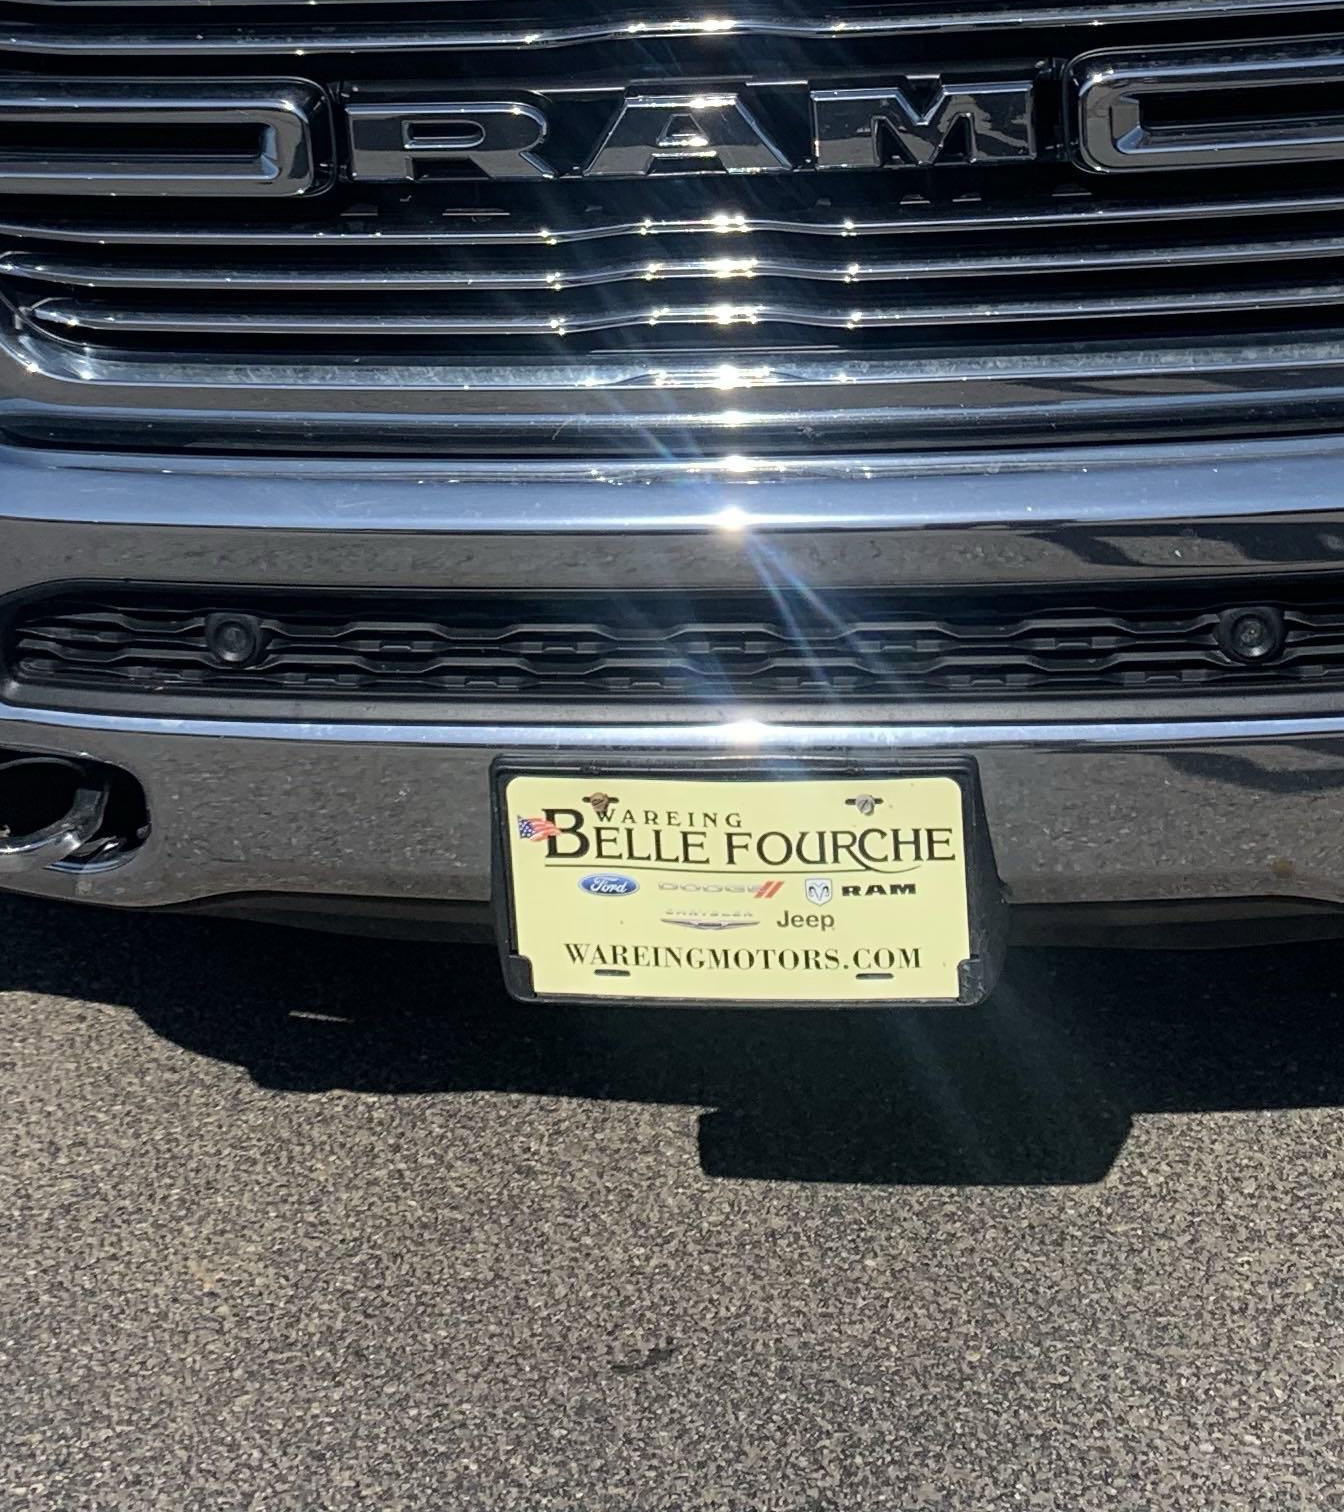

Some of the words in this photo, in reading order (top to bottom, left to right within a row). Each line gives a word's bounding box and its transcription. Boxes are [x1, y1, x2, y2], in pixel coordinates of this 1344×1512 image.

[344, 81, 1038, 181] RAM
[595, 808, 743, 828] WAREING
[541, 807, 710, 865] BELLE
[725, 827, 956, 871] FOURCHE
[589, 876, 629, 895] Ford
[841, 883, 917, 897] RAM
[776, 910, 835, 932] Jeep
[563, 942, 922, 970] WAREINGMOTORS.COM
